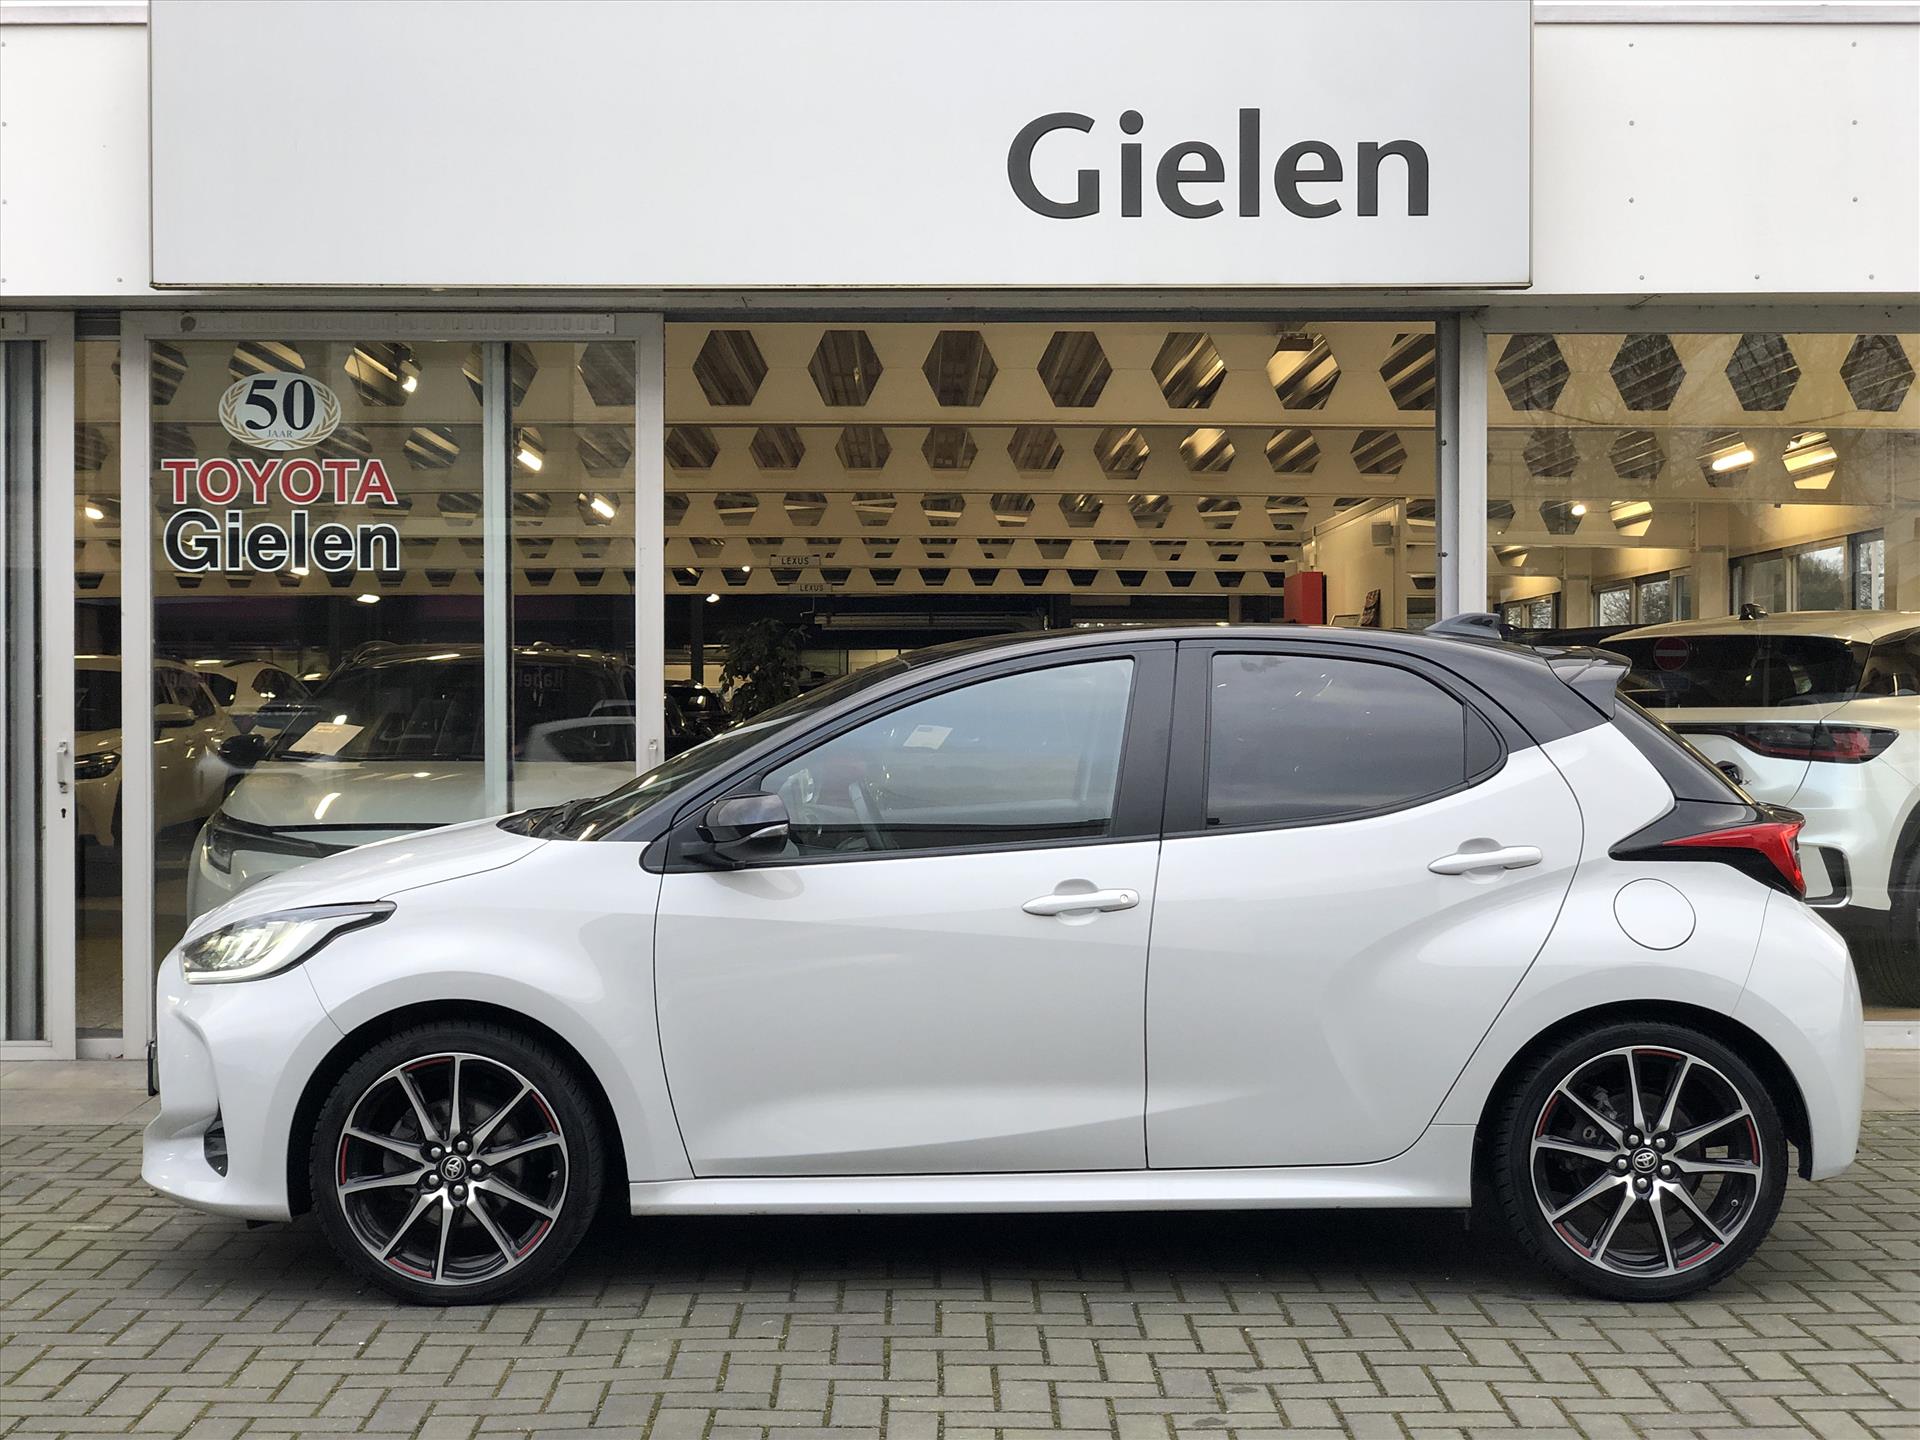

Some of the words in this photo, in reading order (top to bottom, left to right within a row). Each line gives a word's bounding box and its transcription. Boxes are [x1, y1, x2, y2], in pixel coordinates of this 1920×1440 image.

[1007, 107, 1430, 220] Gielen
[245, 379, 315, 431] 50
[267, 430, 293, 438] JAAR
[161, 458, 399, 505] TOYOTA
[163, 508, 401, 573] Gielen
[781, 557, 809, 565] LEXUS
[800, 584, 824, 592] LEXUS
